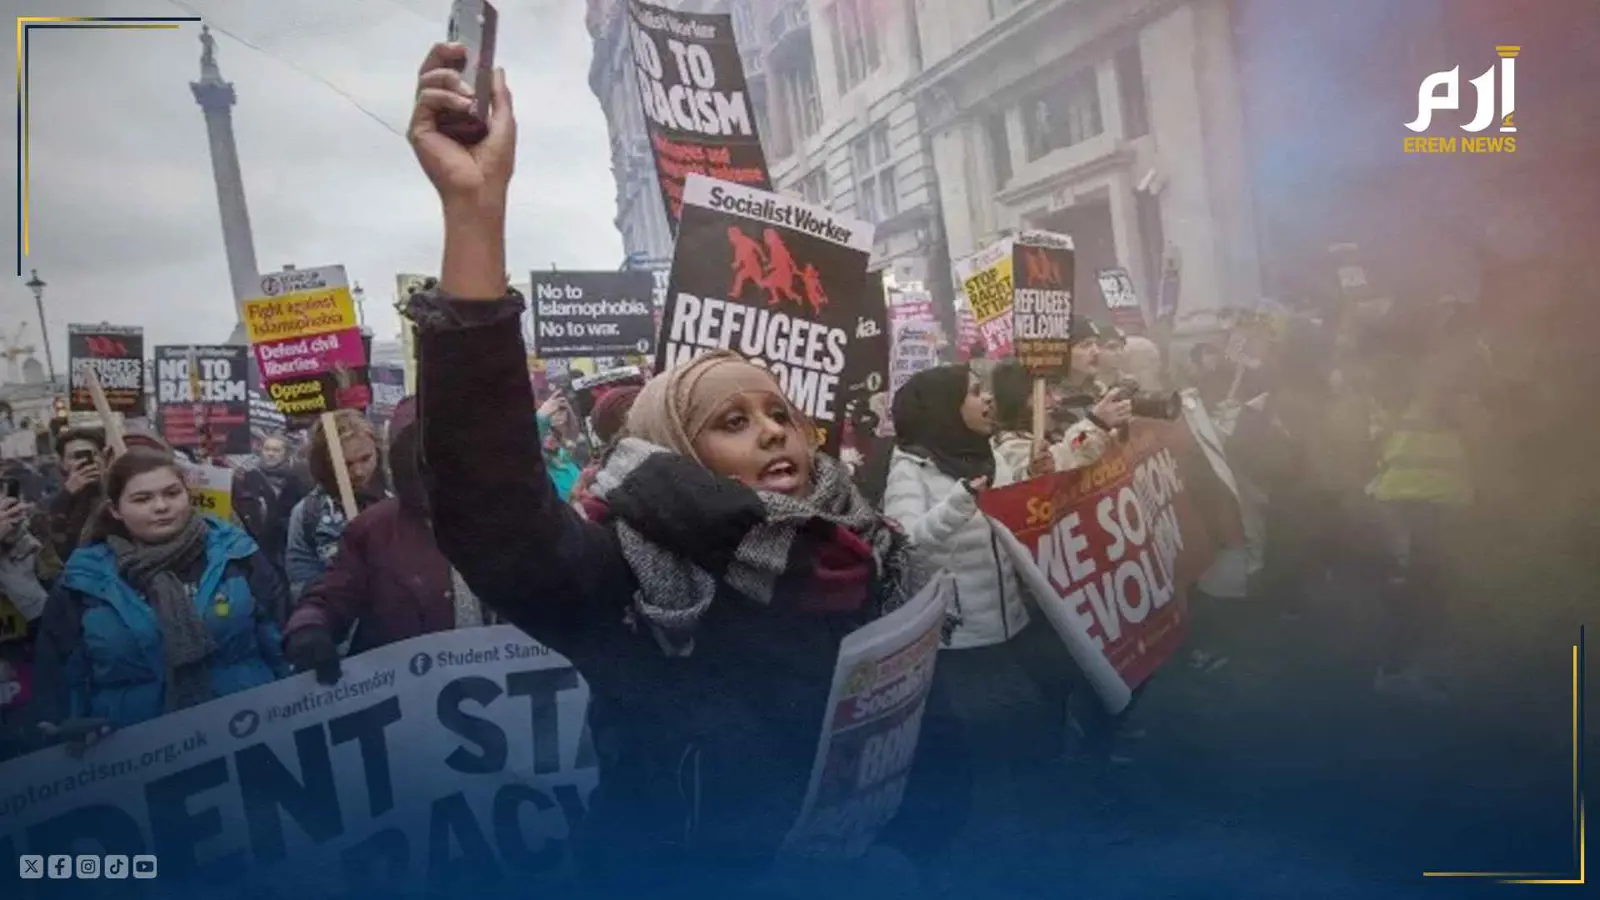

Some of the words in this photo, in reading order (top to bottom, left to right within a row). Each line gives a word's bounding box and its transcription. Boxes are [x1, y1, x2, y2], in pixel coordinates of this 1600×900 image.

[668, 39, 715, 89] TO
[638, 66, 752, 136] RACISM
[537, 283, 563, 300] No
[564, 283, 584, 300] to
[965, 267, 999, 293] STOP
[247, 302, 284, 320] Fight
[288, 296, 338, 315] against
[1014, 288, 1072, 315] REFUGEES
[540, 321, 564, 337] No
[566, 321, 586, 337] to
[587, 322, 620, 337] war.
[670, 292, 849, 375] REFUGEES
[1014, 313, 1070, 340] WELCOME
[260, 338, 309, 361] Defend
[310, 334, 340, 353] civil
[158, 360, 190, 381] NO
[201, 359, 232, 381] TO
[263, 357, 320, 377] liberties
[159, 380, 247, 403] RAISM
[269, 380, 323, 401] Oppose
[276, 394, 327, 414] Prevent
[436, 647, 501, 669] Student
